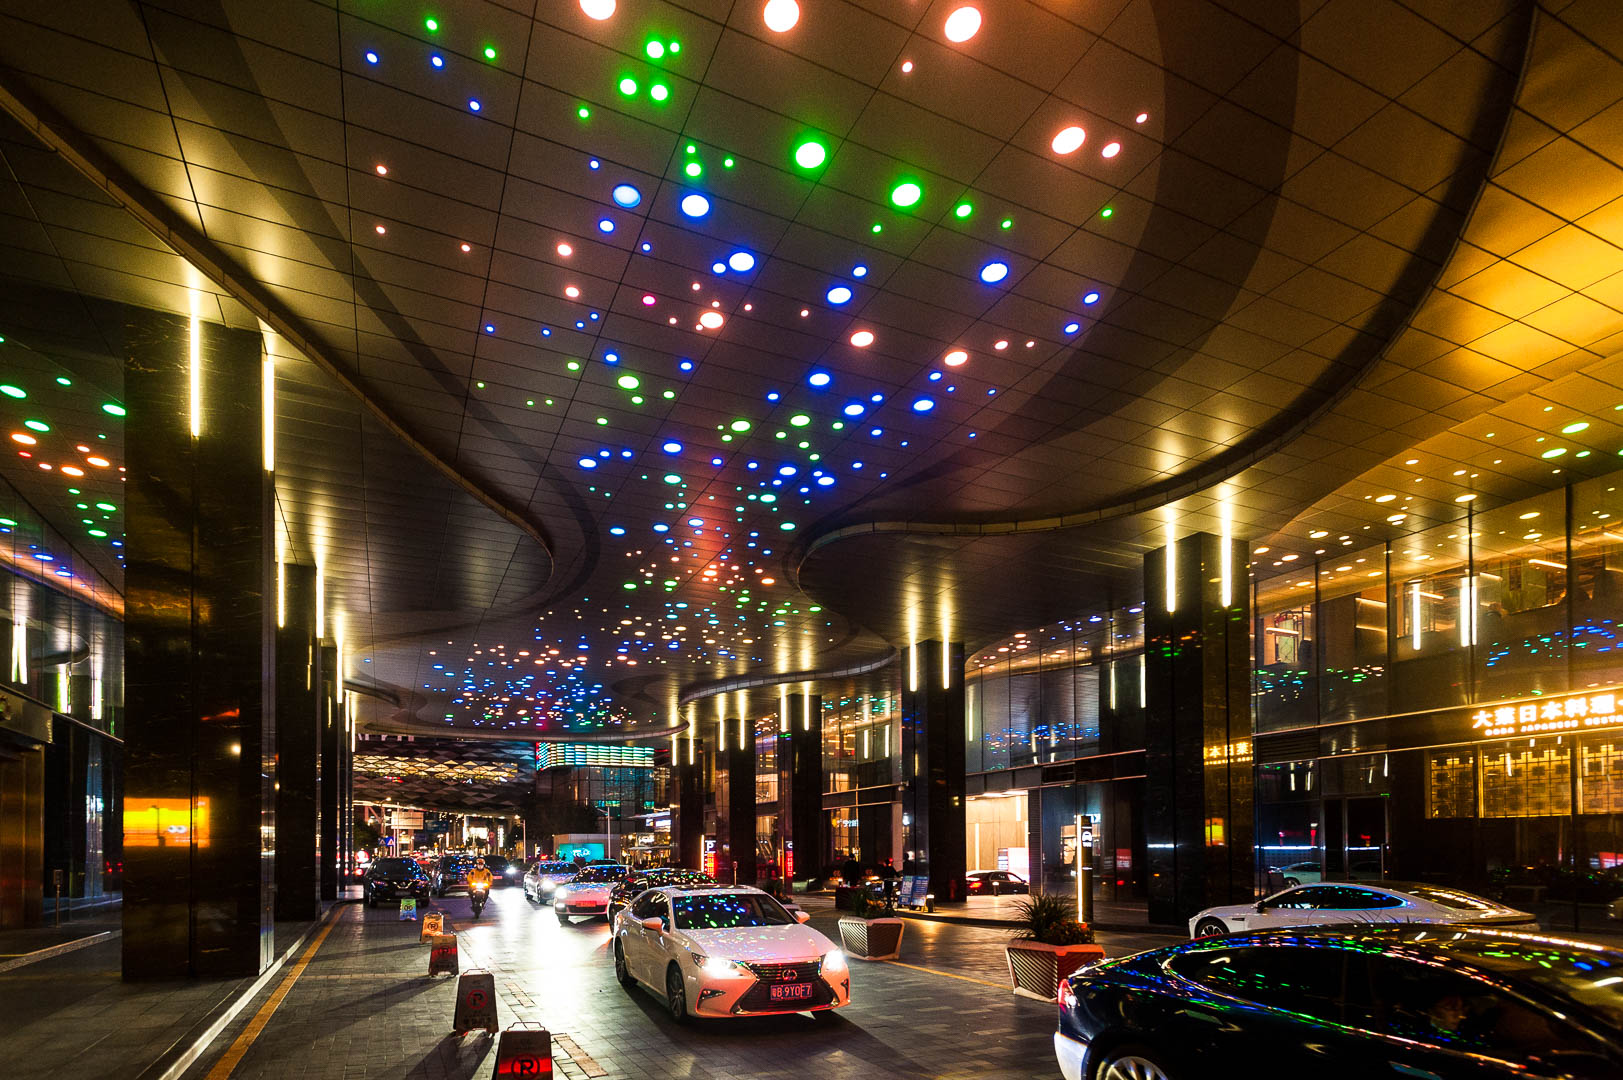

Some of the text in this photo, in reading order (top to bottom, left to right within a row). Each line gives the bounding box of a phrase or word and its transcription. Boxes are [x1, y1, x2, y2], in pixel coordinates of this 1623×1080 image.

[1472, 694, 1623, 728] 大葉日本料理
